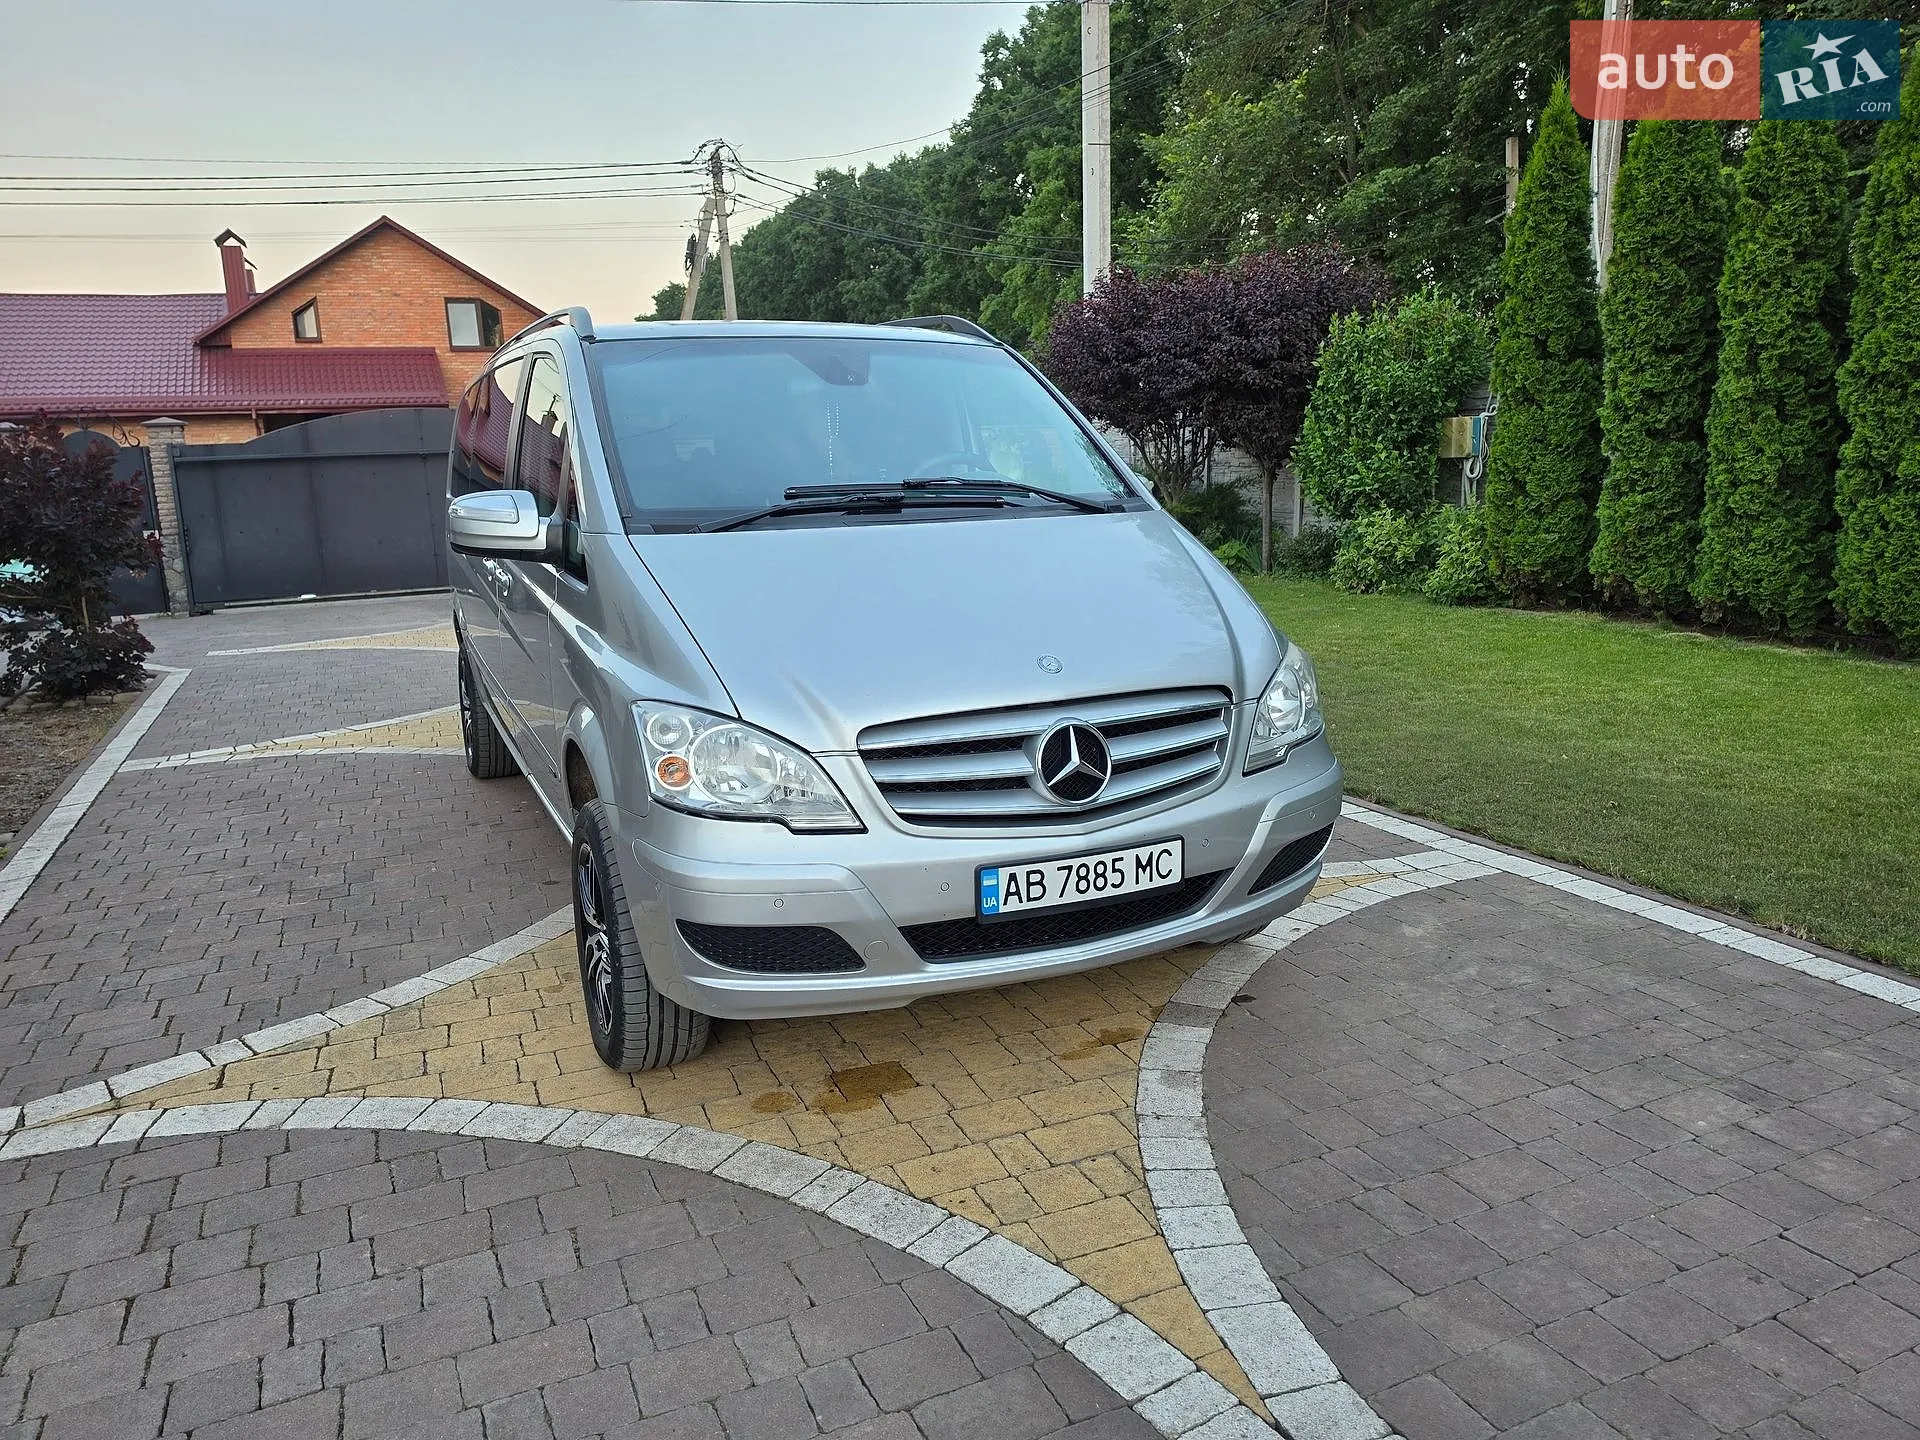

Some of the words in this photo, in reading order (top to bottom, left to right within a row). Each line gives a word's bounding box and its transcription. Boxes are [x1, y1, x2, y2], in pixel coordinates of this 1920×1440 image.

[1003, 869, 1047, 906] AB
[1056, 857, 1125, 898] 7885
[1135, 849, 1173, 885] MC
[983, 897, 997, 908] UA
